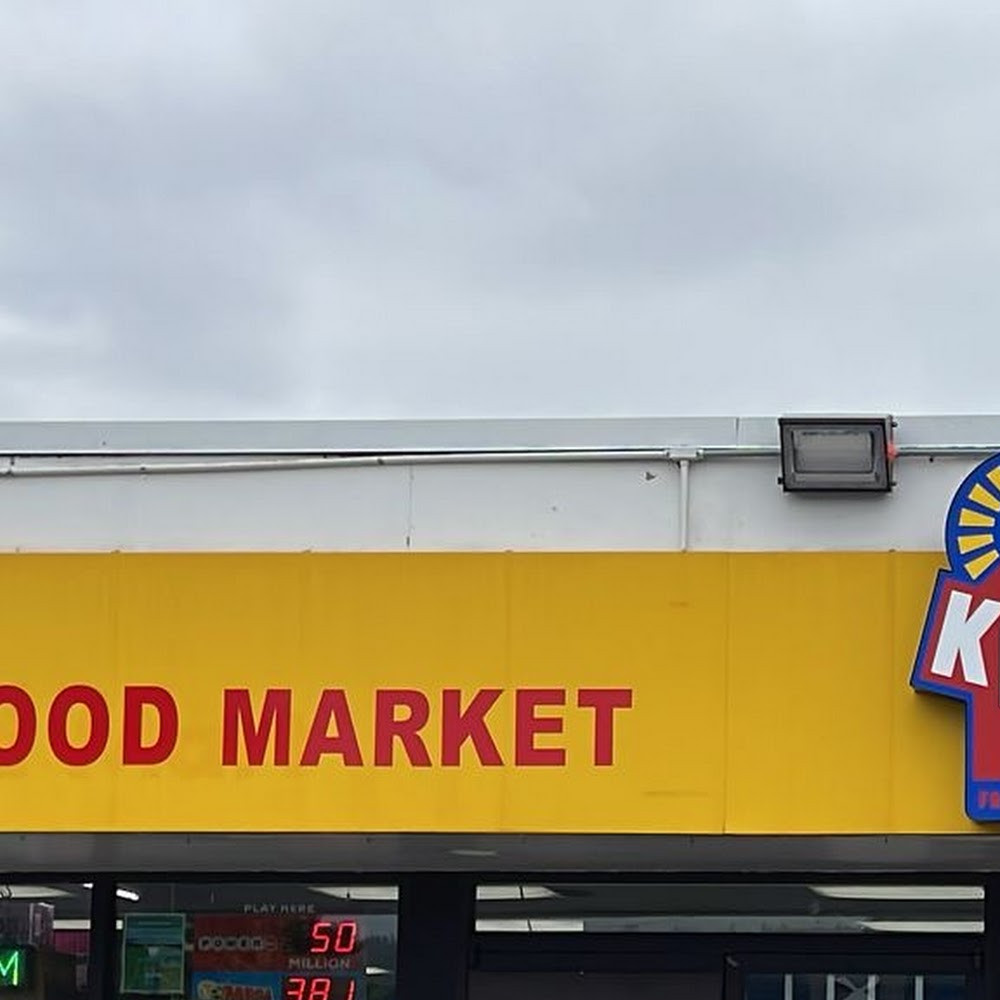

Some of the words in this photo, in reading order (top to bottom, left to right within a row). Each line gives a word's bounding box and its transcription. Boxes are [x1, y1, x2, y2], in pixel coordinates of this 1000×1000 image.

[221, 688, 634, 767] MARKET
[310, 921, 358, 953] 50
[288, 957, 350, 970] MILLION
